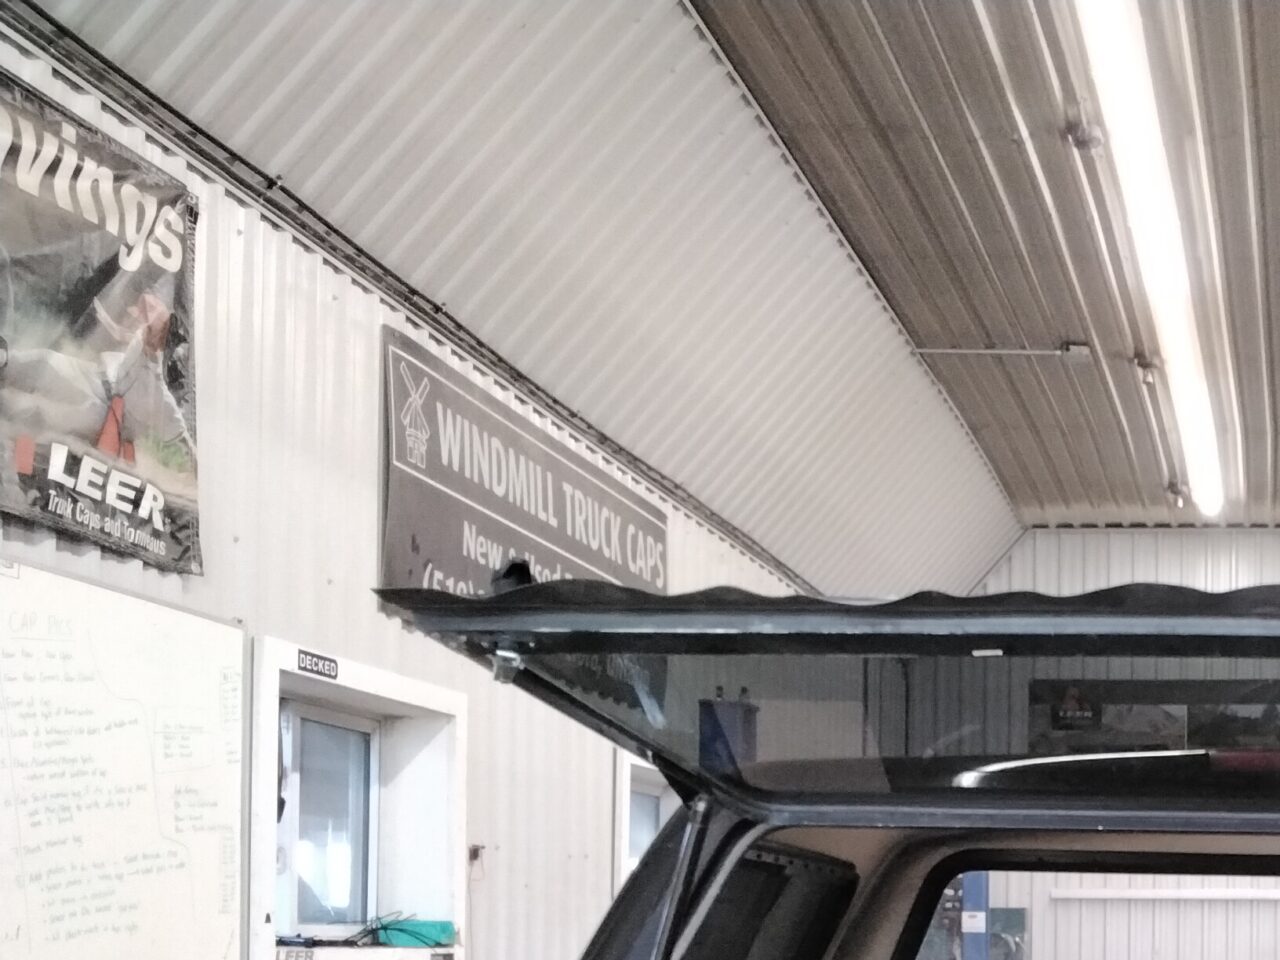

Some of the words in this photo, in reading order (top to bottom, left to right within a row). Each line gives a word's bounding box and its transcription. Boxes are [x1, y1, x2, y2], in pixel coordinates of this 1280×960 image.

[47, 442, 165, 532] LEER
[436, 401, 558, 528] WINDMILL
[562, 482, 622, 565] TRUCK
[627, 523, 664, 589] CAPS
[76, 501, 101, 531] Caps
[104, 517, 121, 537] and
[462, 520, 503, 571] New
[300, 653, 337, 677] DECKED
